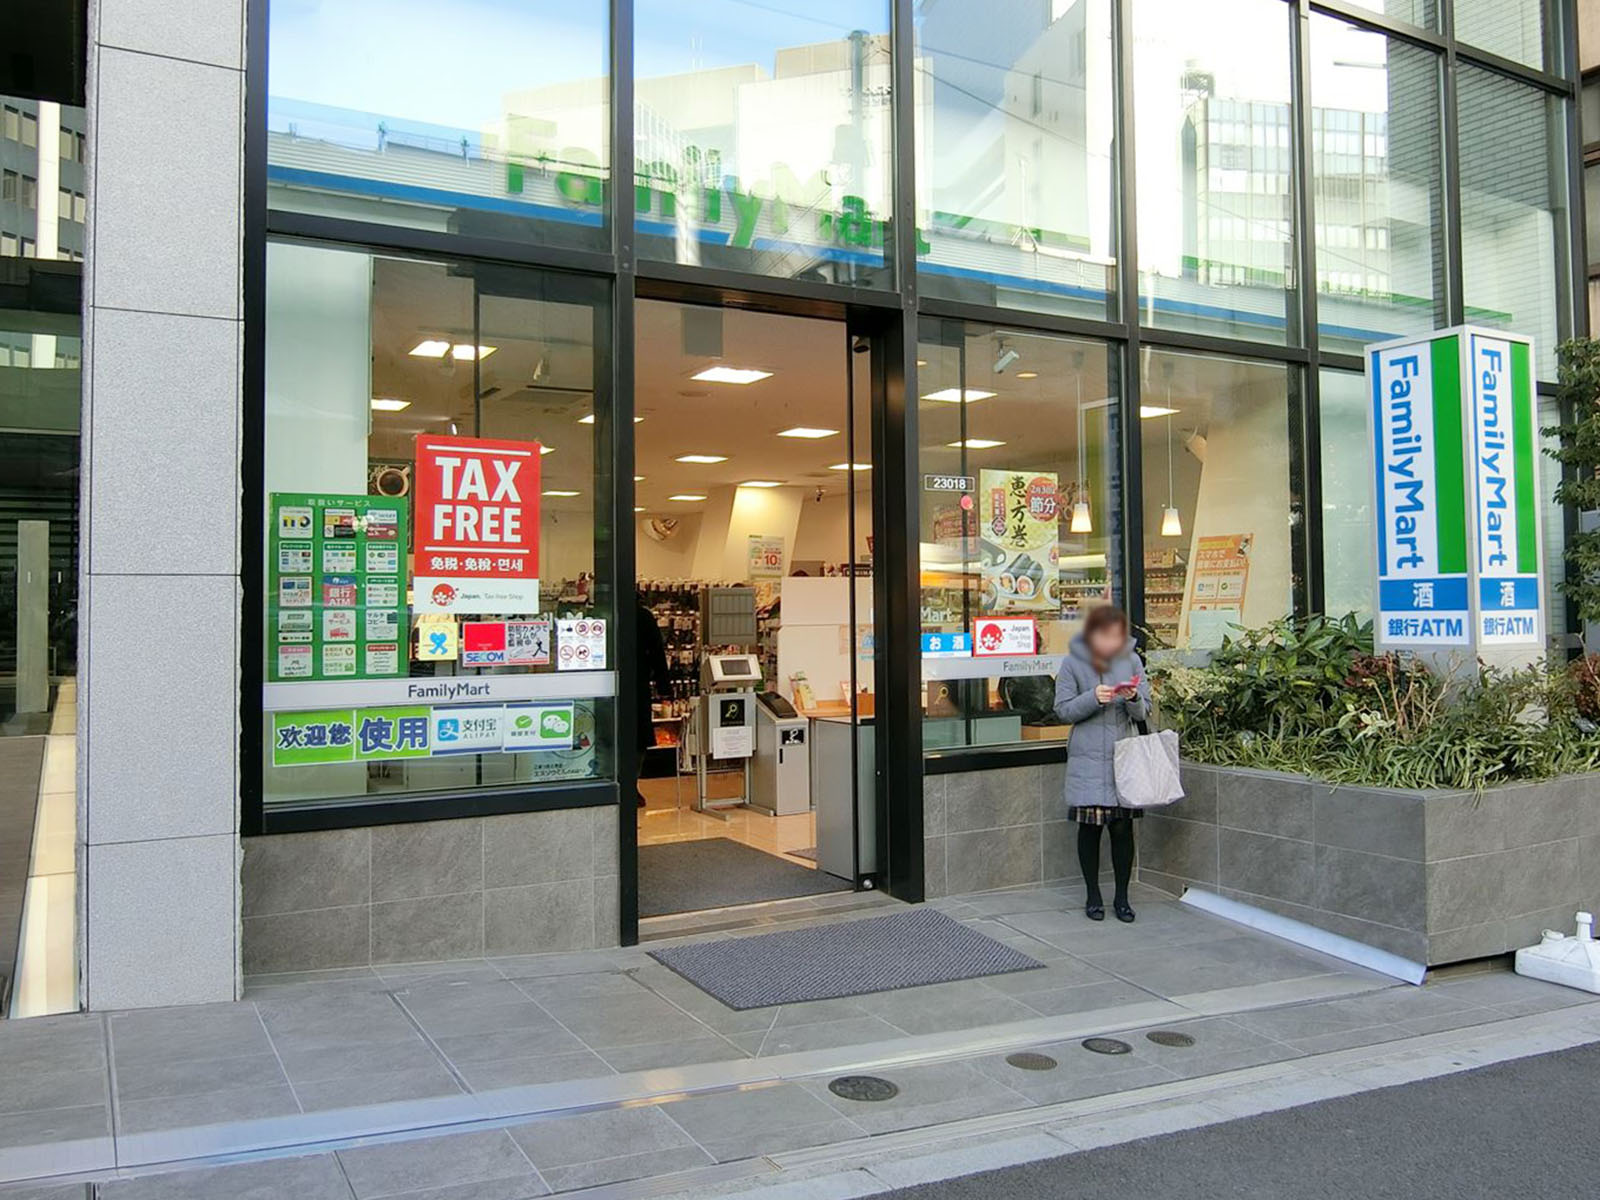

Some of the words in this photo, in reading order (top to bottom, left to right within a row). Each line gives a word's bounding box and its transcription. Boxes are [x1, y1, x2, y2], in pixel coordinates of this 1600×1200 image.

[1388, 354, 1425, 570] FamilyMart
[1480, 348, 1508, 567] FamilyMart
[435, 456, 522, 503] TAX
[933, 477, 967, 490] 23018
[1030, 495, 1057, 515] 節分
[433, 504, 522, 544] FREE
[1412, 582, 1434, 609] 酒
[1500, 581, 1515, 608] 酒
[1388, 618, 1464, 638] 銀行ATM
[1483, 617, 1534, 637] 銀行ATM
[466, 650, 504, 662] SECOM
[1002, 659, 1053, 673] FamilyMart
[408, 682, 491, 700] FamilyMart
[278, 722, 352, 749] 欢迎您
[358, 716, 429, 753] 使用
[462, 717, 497, 732] 支付宝
